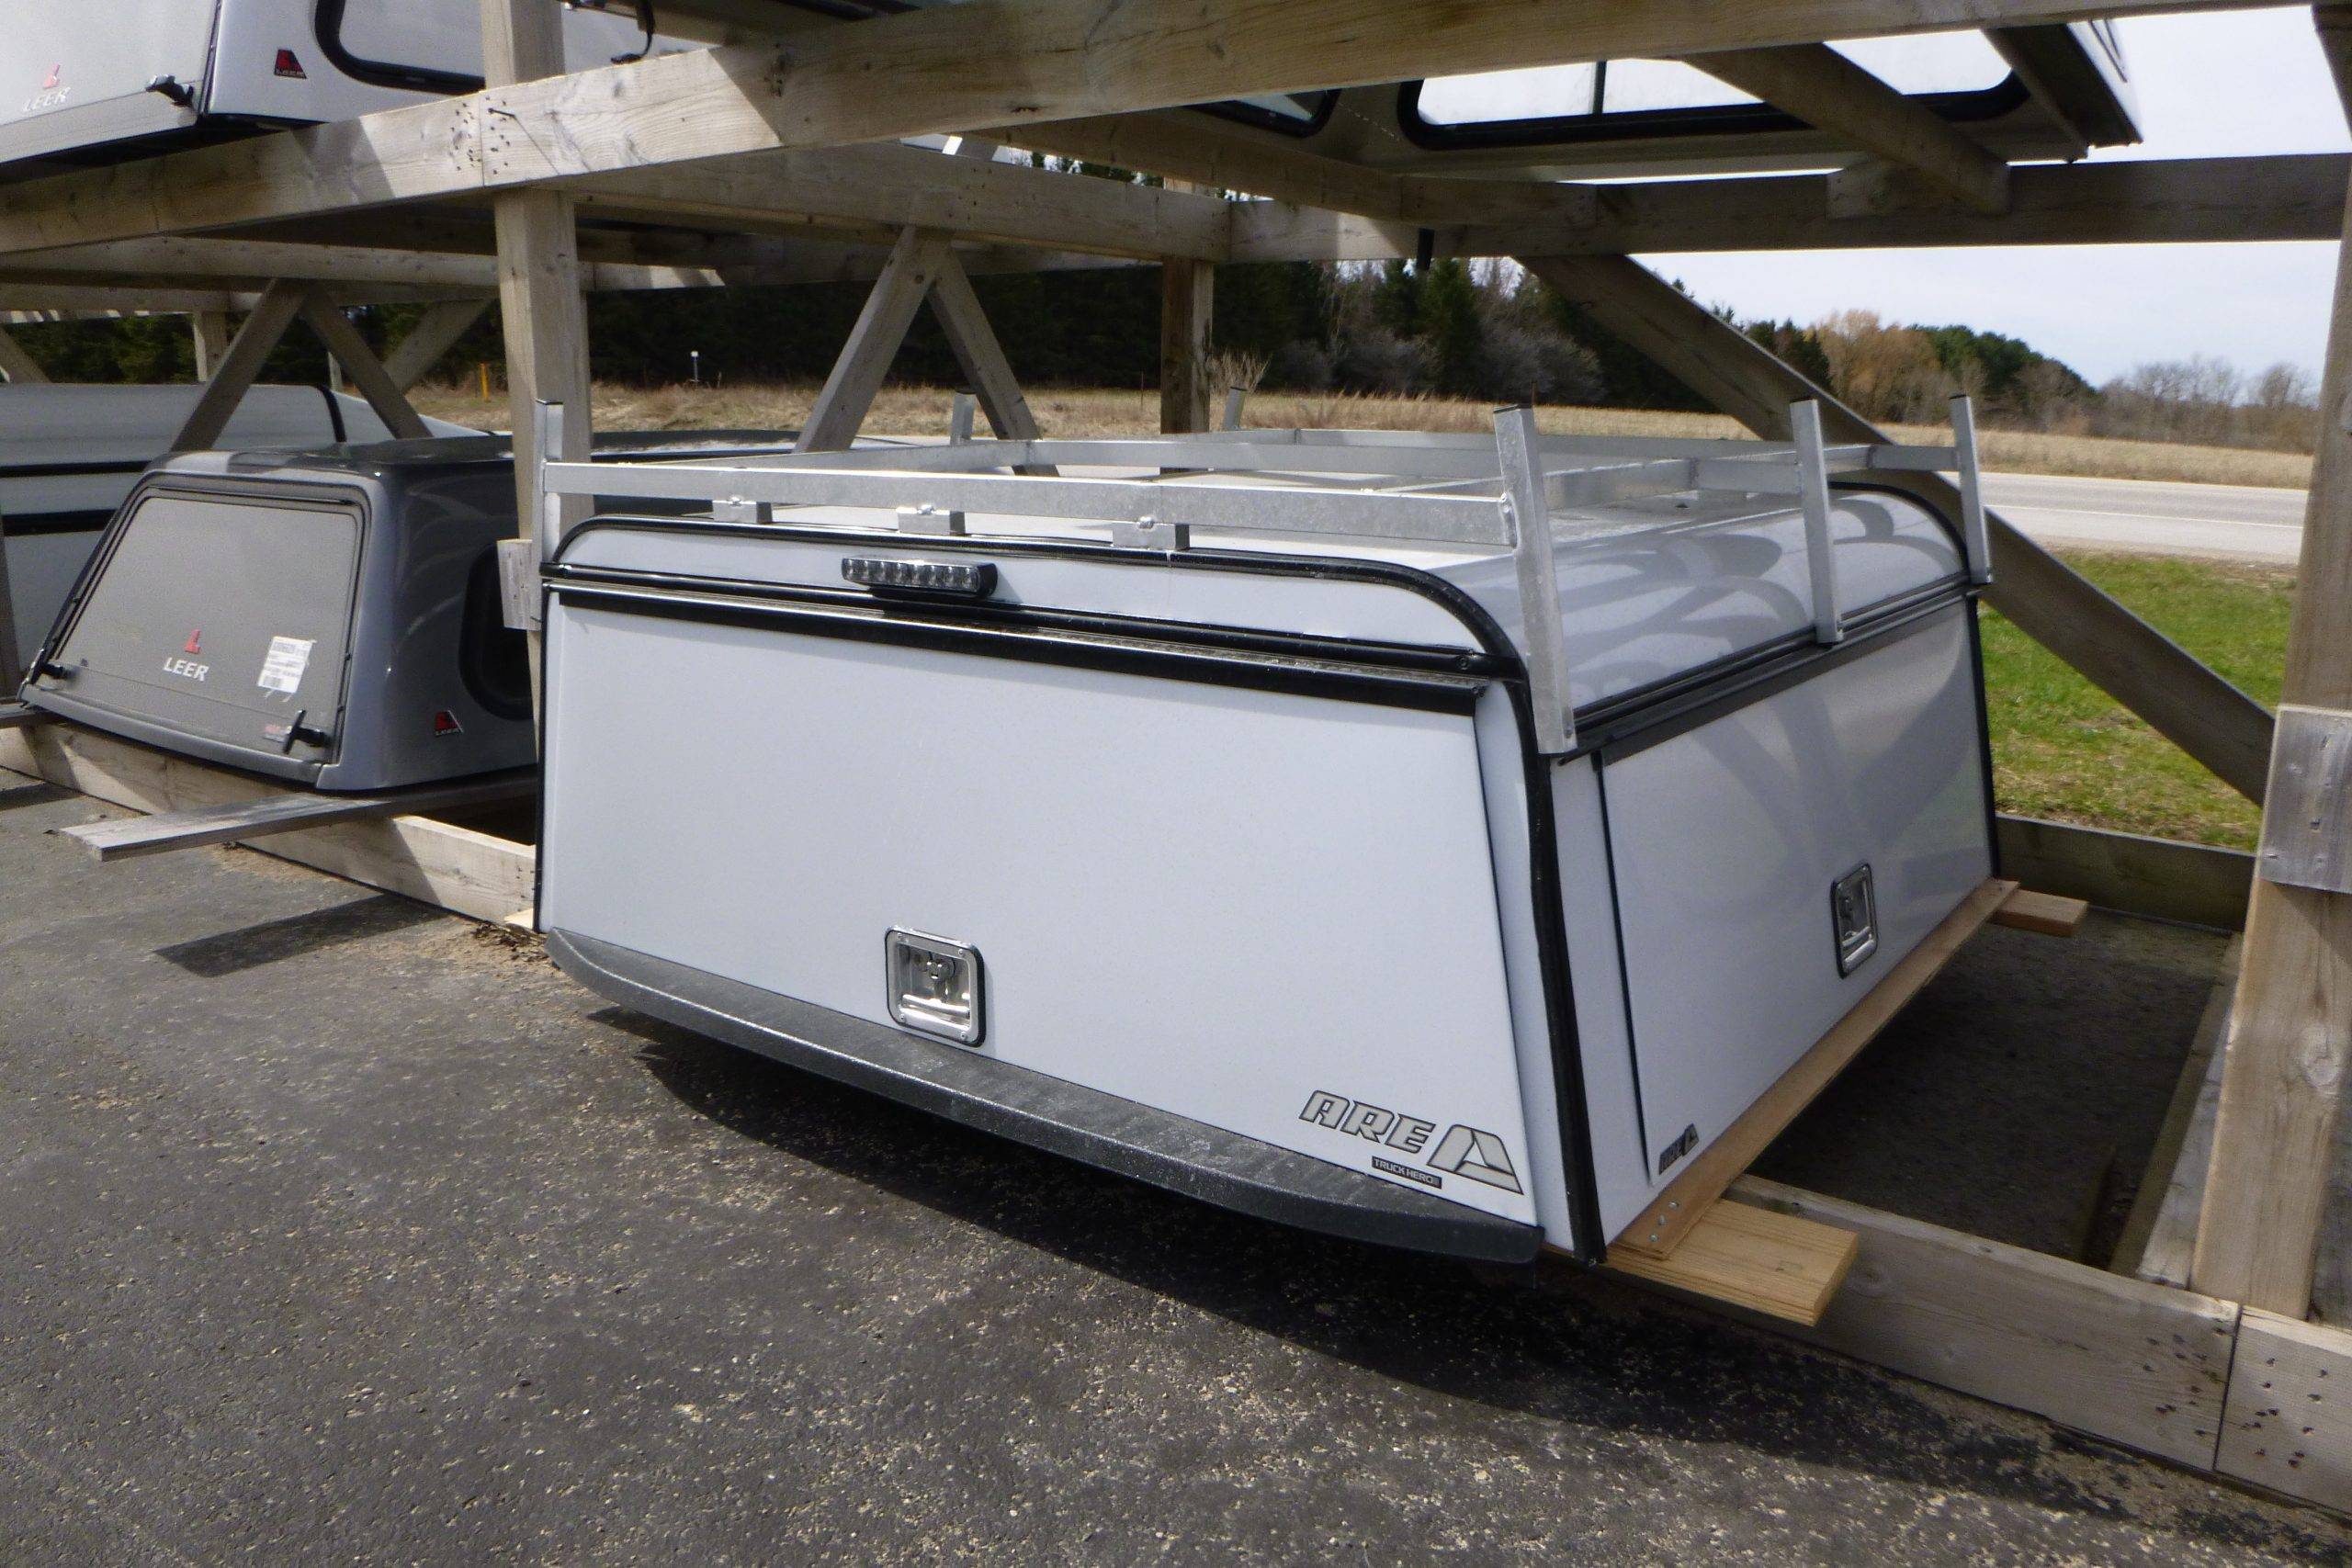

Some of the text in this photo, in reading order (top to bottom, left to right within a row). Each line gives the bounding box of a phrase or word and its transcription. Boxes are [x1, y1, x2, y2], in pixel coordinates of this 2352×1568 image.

[164, 658, 209, 682] LEER
[1374, 1158, 1433, 1184] TRUCK HERO
